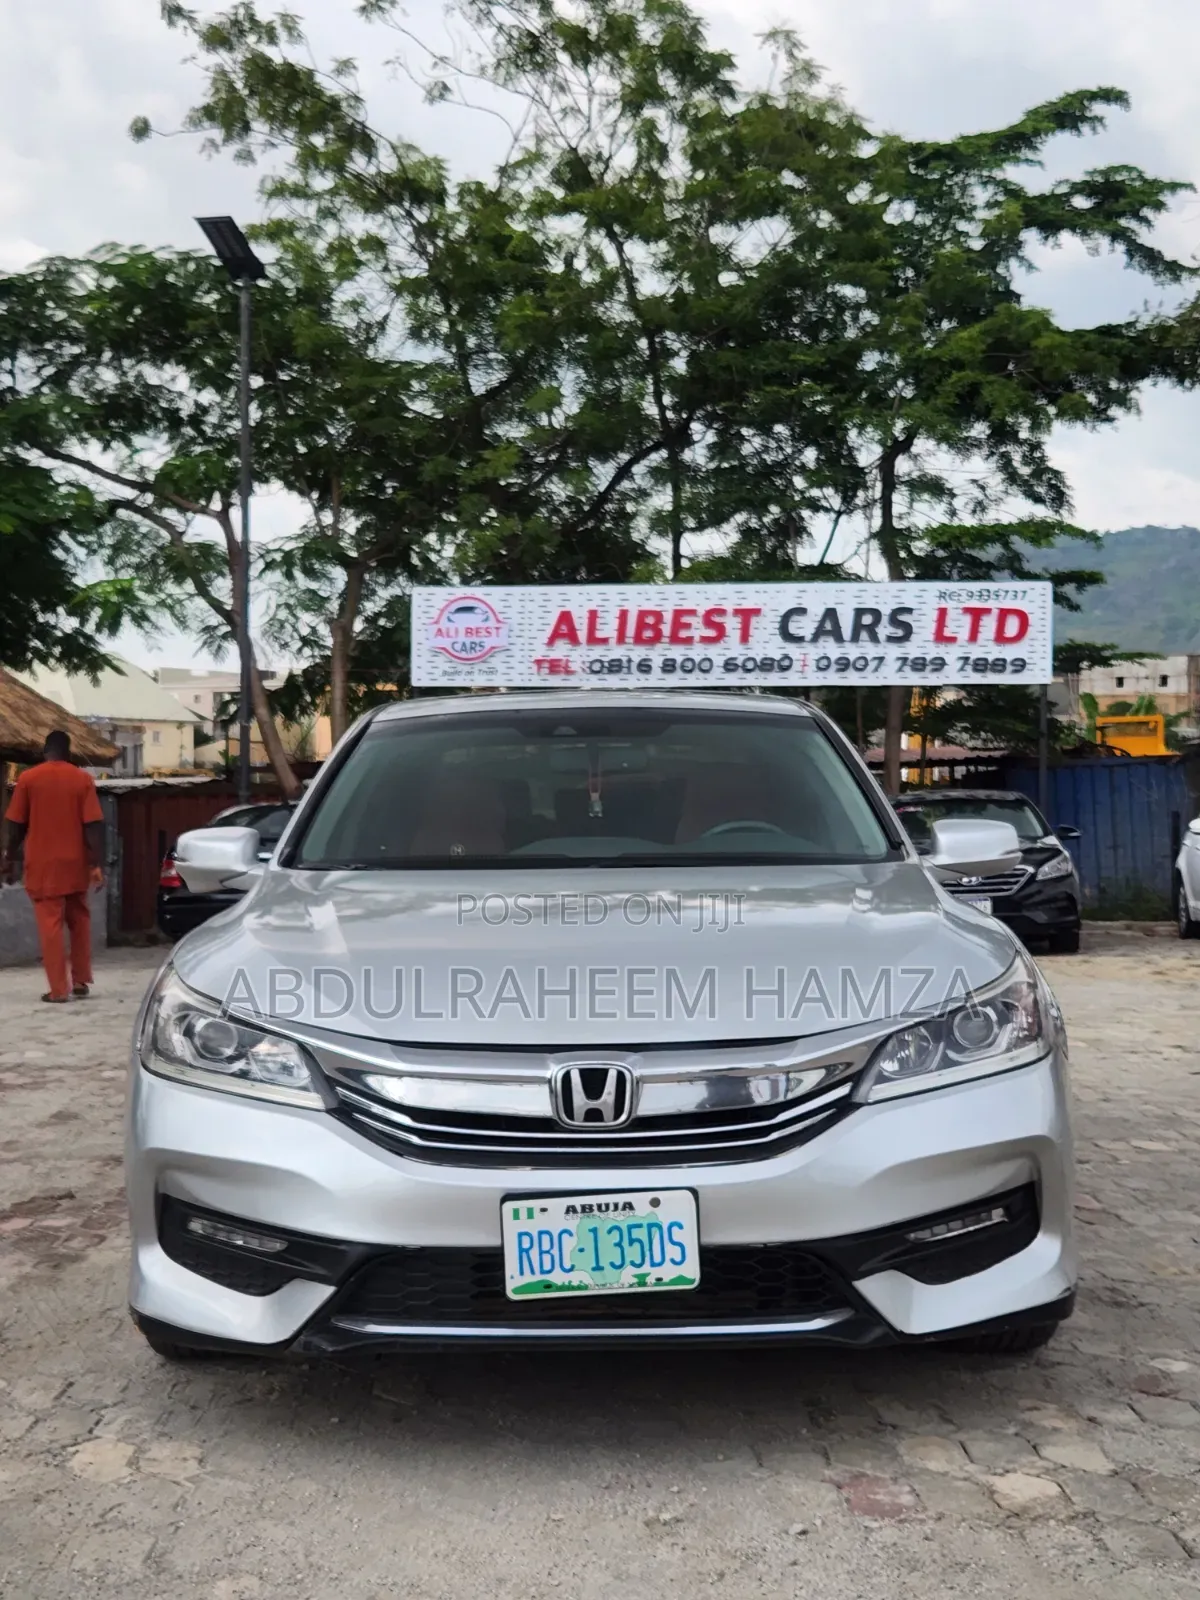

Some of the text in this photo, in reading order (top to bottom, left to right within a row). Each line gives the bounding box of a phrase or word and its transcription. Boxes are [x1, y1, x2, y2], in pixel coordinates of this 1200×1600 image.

[434, 626, 501, 638] ALI BEST
[546, 606, 1030, 647] ALIBEST CARS LTD
[451, 641, 485, 654] CARS
[588, 657, 653, 675] 0816
[660, 657, 714, 674] 800
[722, 655, 794, 674] 6080
[815, 655, 886, 673] 0907
[895, 655, 947, 673] 789
[956, 655, 1028, 673] 7889
[564, 1201, 636, 1215] ABUJA
[517, 1221, 687, 1277] RBC-135DS
